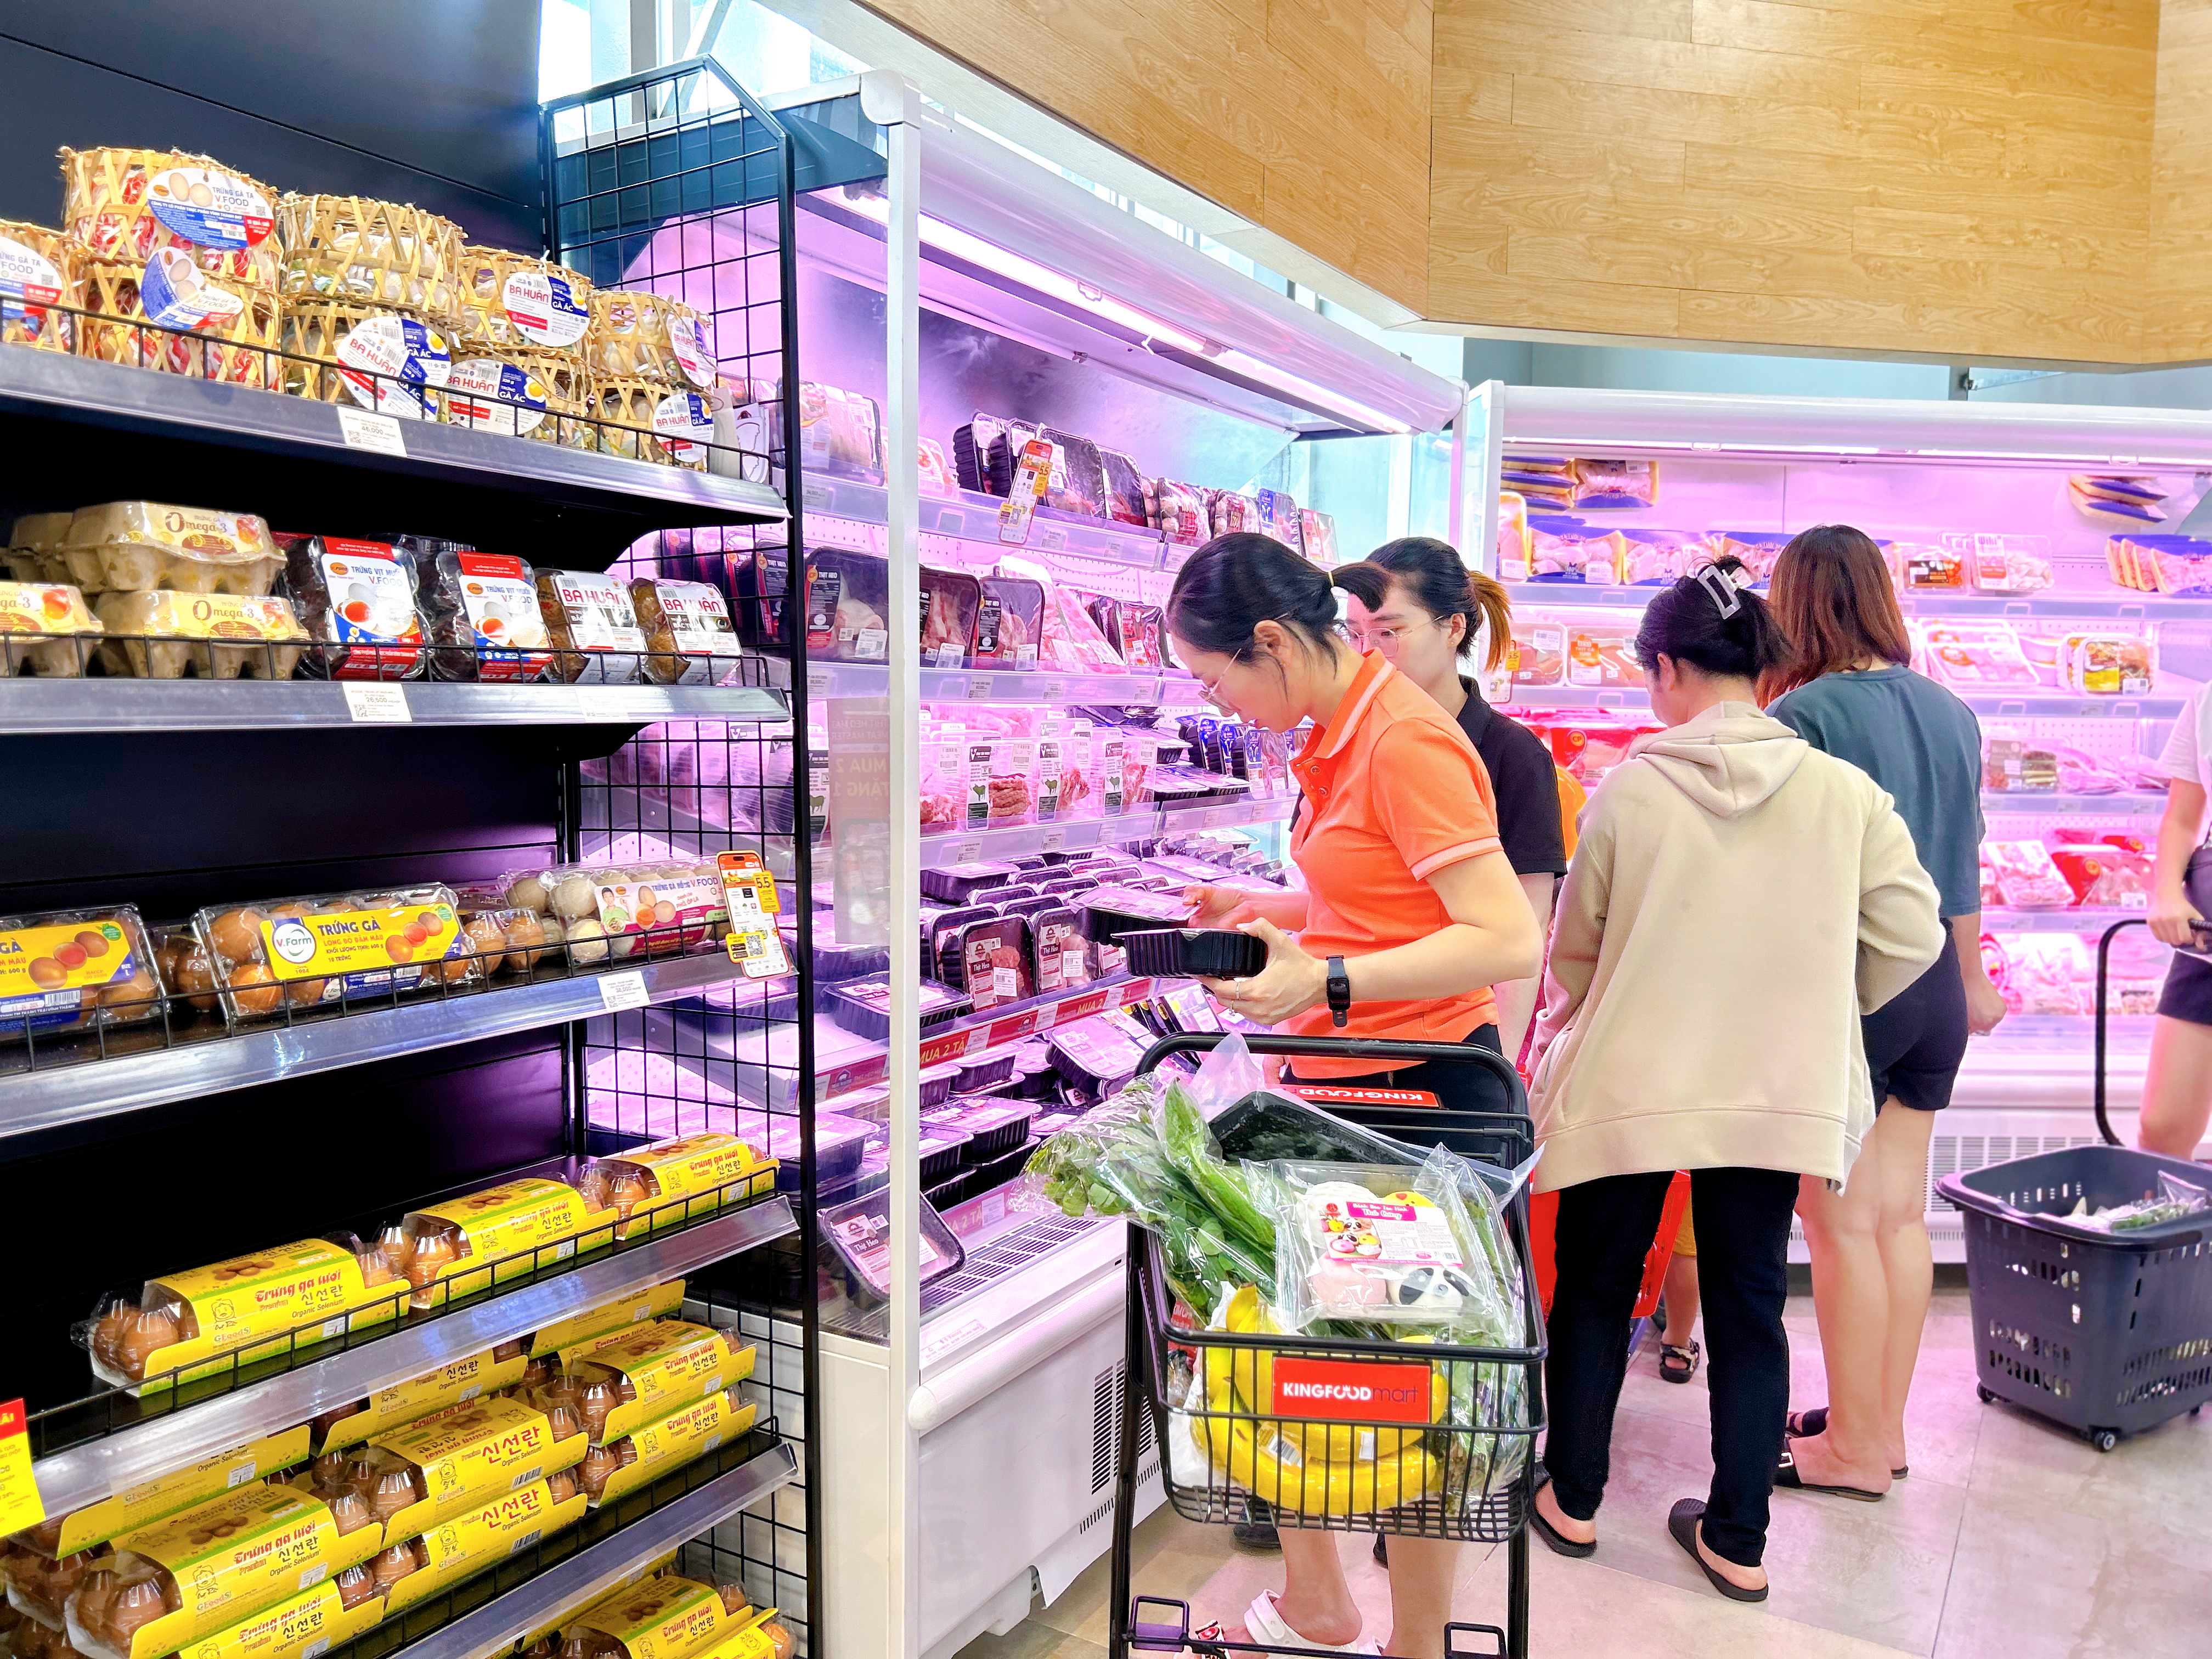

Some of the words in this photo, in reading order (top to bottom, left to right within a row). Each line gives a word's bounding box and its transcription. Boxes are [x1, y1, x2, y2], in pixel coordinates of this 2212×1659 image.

[215, 194, 249, 207] V.FOOD
[509, 285, 522, 296] BA
[524, 289, 549, 302] HUÂN
[564, 303, 573, 312] ÁC
[350, 338, 366, 354] BA
[366, 349, 397, 376] HUÂN
[420, 348, 432, 358] ÁC
[409, 388, 421, 399] ÁC
[463, 380, 494, 393] HUÂN
[499, 391, 511, 399] GÀ
[514, 394, 526, 403] ÁC
[656, 417, 669, 427] BA
[669, 414, 690, 425] HUÂN
[362, 426, 383, 435] 46,000
[351, 566, 373, 574] TRỨNG
[374, 568, 384, 577] VỊT
[369, 576, 403, 586] V.FOOD
[562, 589, 583, 602] BA
[663, 599, 685, 611] BA
[691, 877, 719, 887] V.FOOD
[318, 919, 359, 936] TRỨNG
[362, 916, 381, 932] GÀ
[0, 938, 24, 954] GÀ
[275, 935, 313, 948] V.Farm
[8, 956, 26, 966] MÀU
[1077, 1003, 1095, 1016] MUA
[1096, 998, 1104, 1010] 2
[943, 1044, 951, 1057] 2
[1299, 1088, 1423, 1101] KINGFOOD
[542, 1211, 573, 1229] 신선란
[962, 1216, 968, 1229] 2
[854, 1242, 867, 1252] Thịt
[866, 1238, 879, 1248] Heo
[301, 1284, 343, 1306] 신선란
[292, 1306, 316, 1319] Organic
[317, 1297, 346, 1311] Selenium
[447, 1360, 479, 1380] 신선란
[692, 1353, 718, 1371] 신선란
[482, 1426, 540, 1465] 신선란
[198, 1459, 221, 1472] Organic
[221, 1447, 249, 1463] Selenium
[502, 1455, 521, 1467] Organic
[521, 1445, 543, 1460] Selenium
[482, 1489, 540, 1529] 신선란
[502, 1519, 521, 1531] Organic
[521, 1508, 543, 1522] Selenium
[278, 1536, 319, 1563] 신선란
[269, 1561, 292, 1577] Organic
[294, 1548, 321, 1567] Selenium
[283, 1611, 323, 1639] 신선란
[689, 1615, 715, 1637] 신선란
[273, 1638, 296, 1654] Organic
[297, 1624, 325, 1643] Selenium
